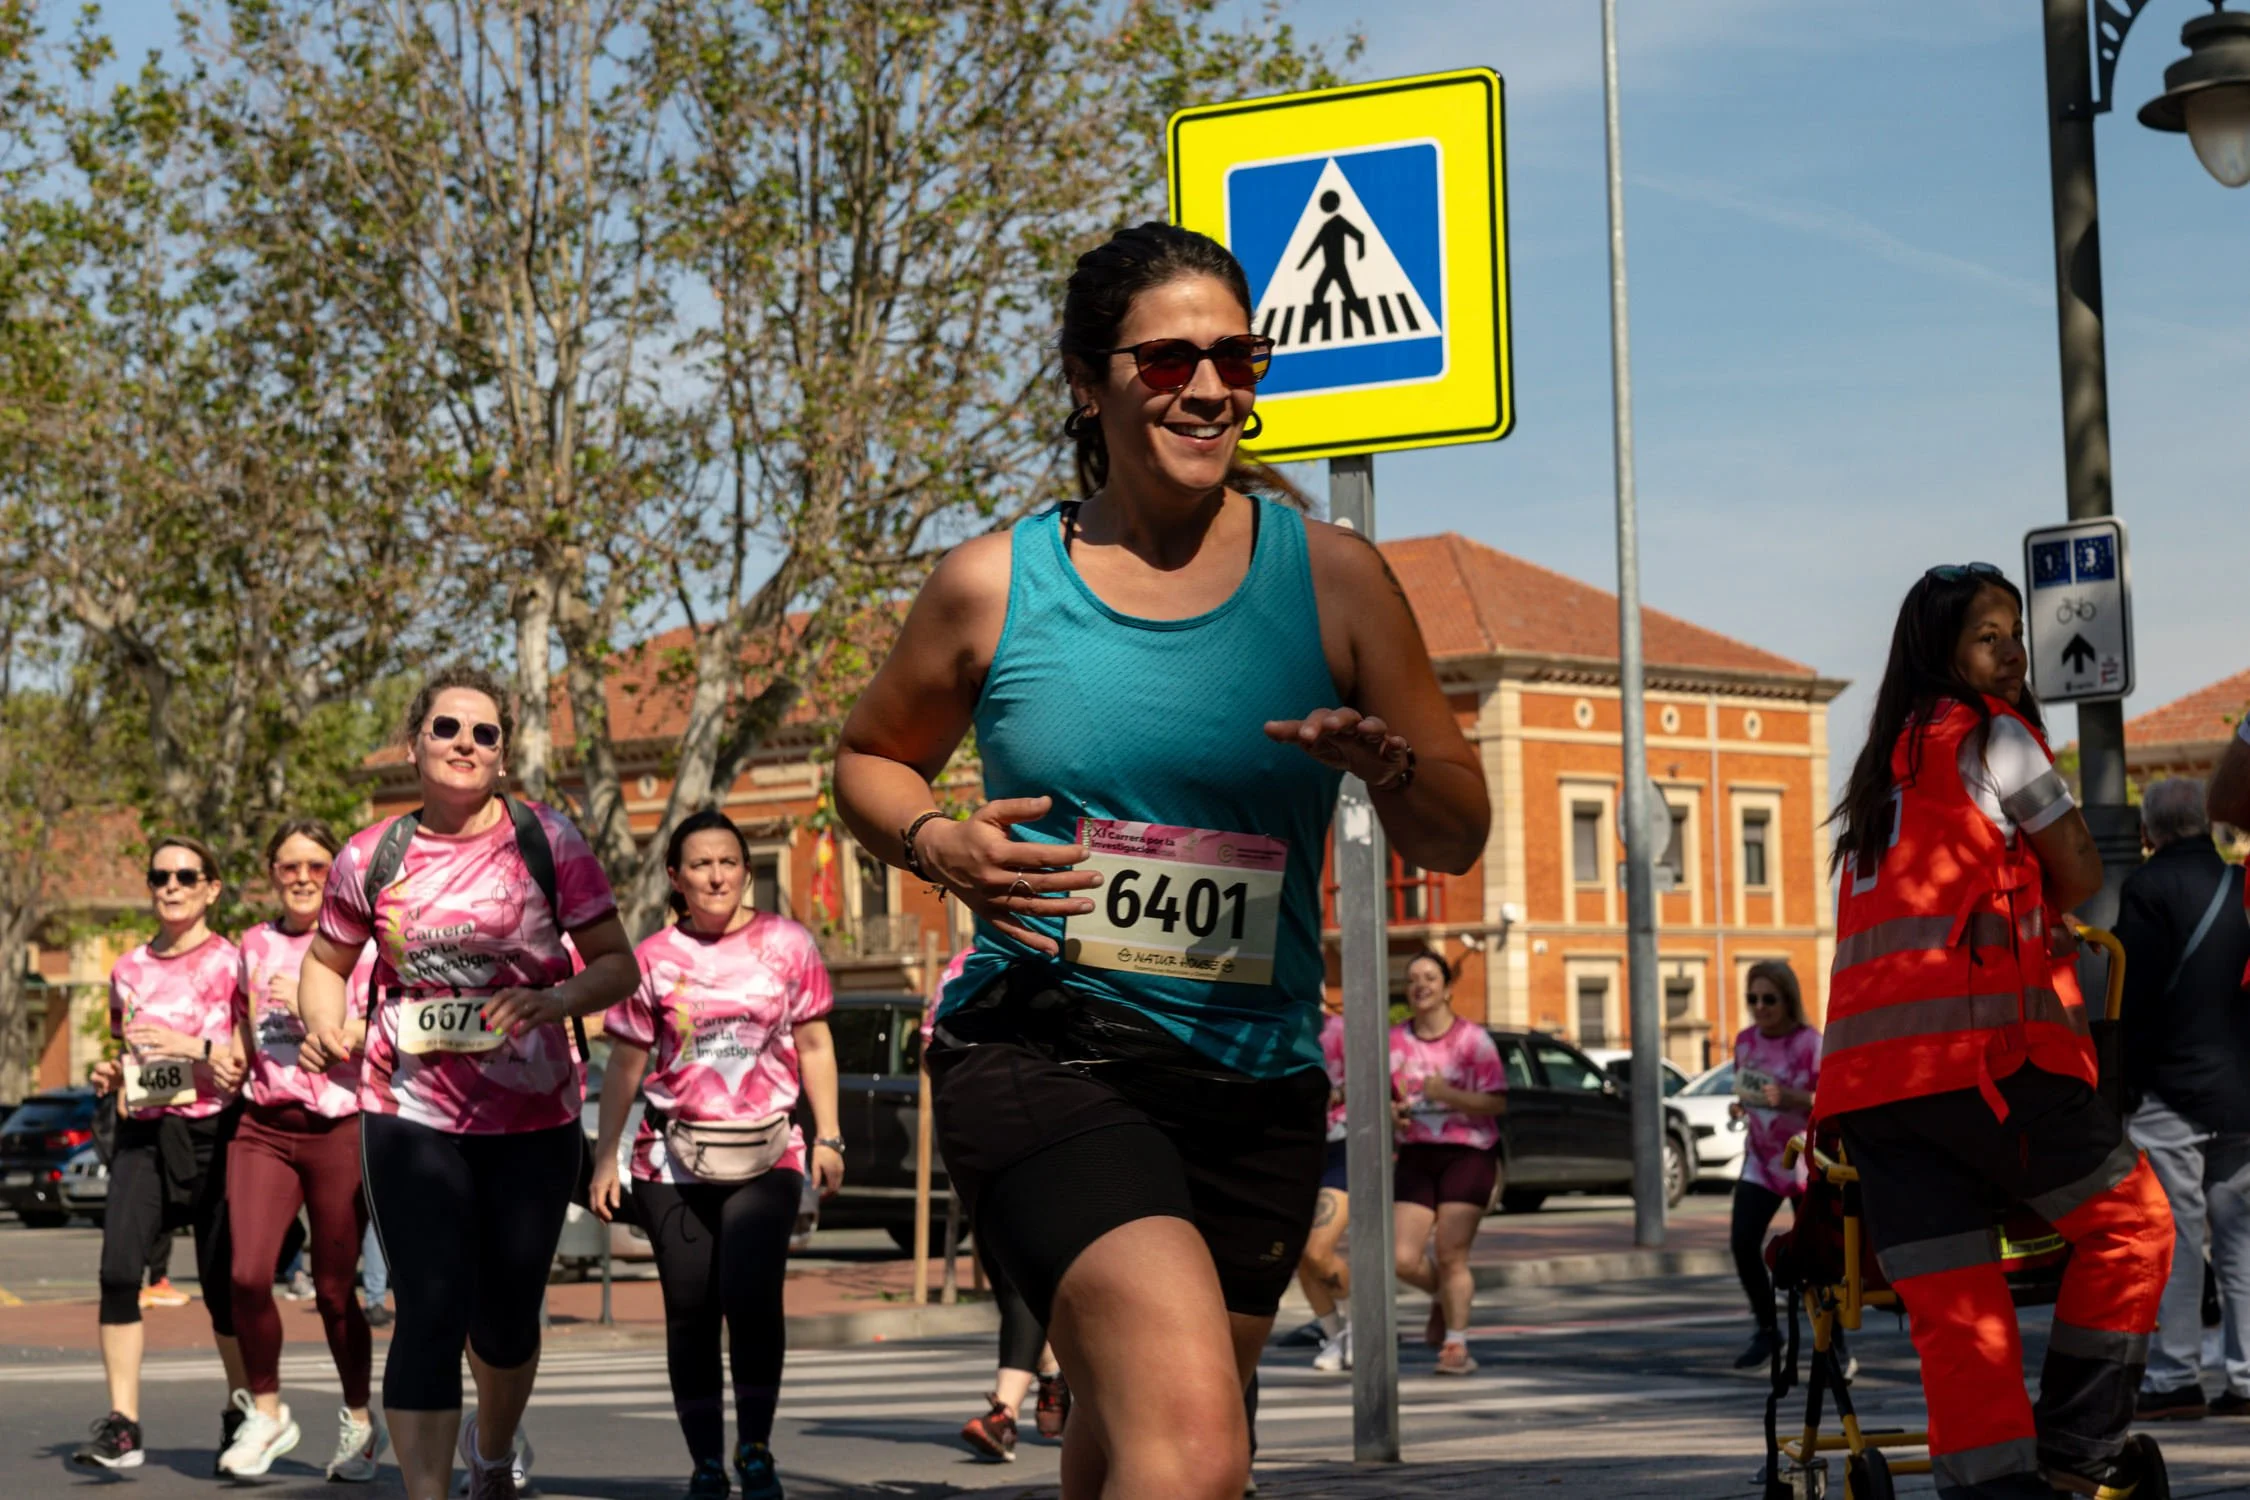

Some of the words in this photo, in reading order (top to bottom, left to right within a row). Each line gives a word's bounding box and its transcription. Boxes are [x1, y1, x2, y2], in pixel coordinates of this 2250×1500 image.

[2085, 547, 2097, 569] 3
[1108, 831, 1146, 843] Carrera
[1146, 837, 1163, 848] por
[1164, 838, 1175, 846] la
[1106, 869, 1248, 940] 6401
[404, 923, 473, 942] Carrera
[409, 946, 438, 961] por
[693, 1014, 749, 1029] Carrera
[696, 1032, 717, 1046] por
